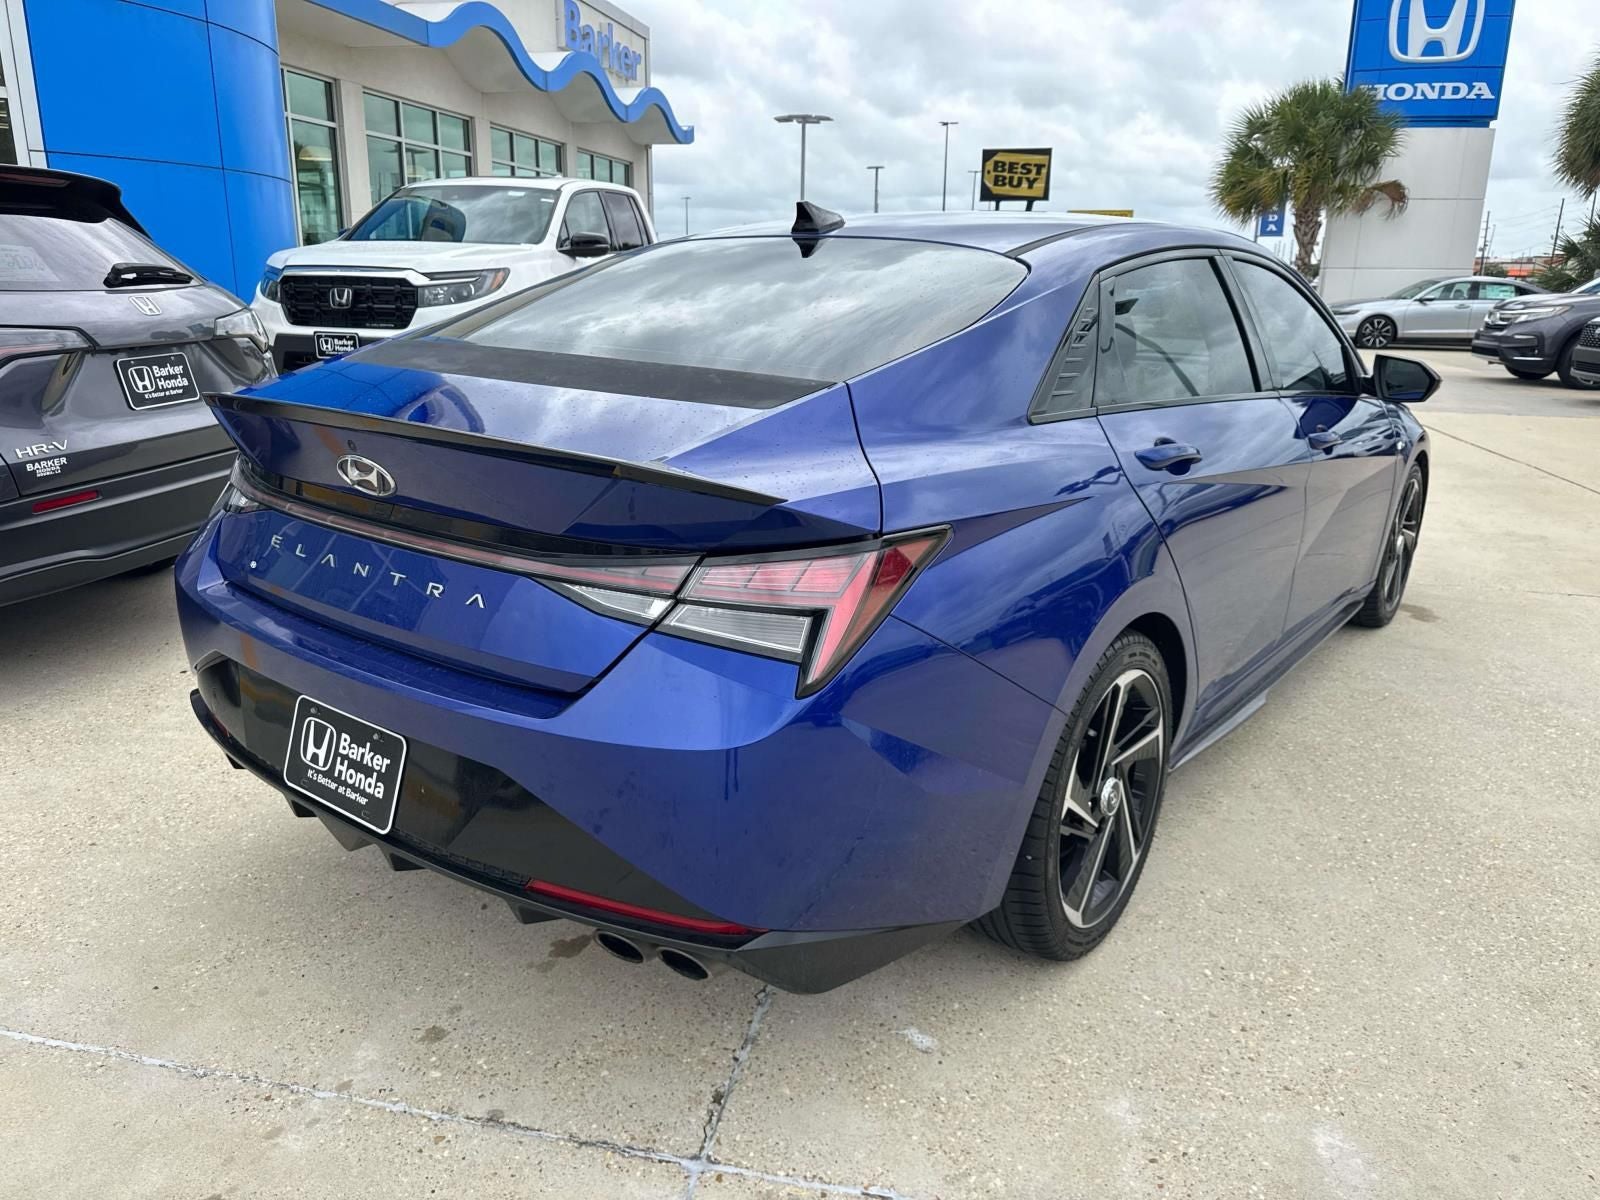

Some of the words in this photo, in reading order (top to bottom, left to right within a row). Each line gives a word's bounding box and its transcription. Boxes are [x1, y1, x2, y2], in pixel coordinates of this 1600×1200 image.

[564, 0, 642, 81] Barker
[993, 160, 1046, 176] BEST
[993, 174, 1040, 190] BUY
[334, 338, 354, 346] Barker
[152, 363, 184, 377] Barker
[157, 375, 189, 390] Honda
[15, 440, 68, 459] HR-V
[25, 457, 68, 472] BARKER
[271, 534, 486, 609] ELANTRA
[338, 732, 391, 773] Barker
[334, 756, 385, 799] Honda
[307, 769, 318, 781] It's
[317, 773, 338, 790] Better
[337, 785, 346, 795] at
[345, 787, 369, 805] Barker
